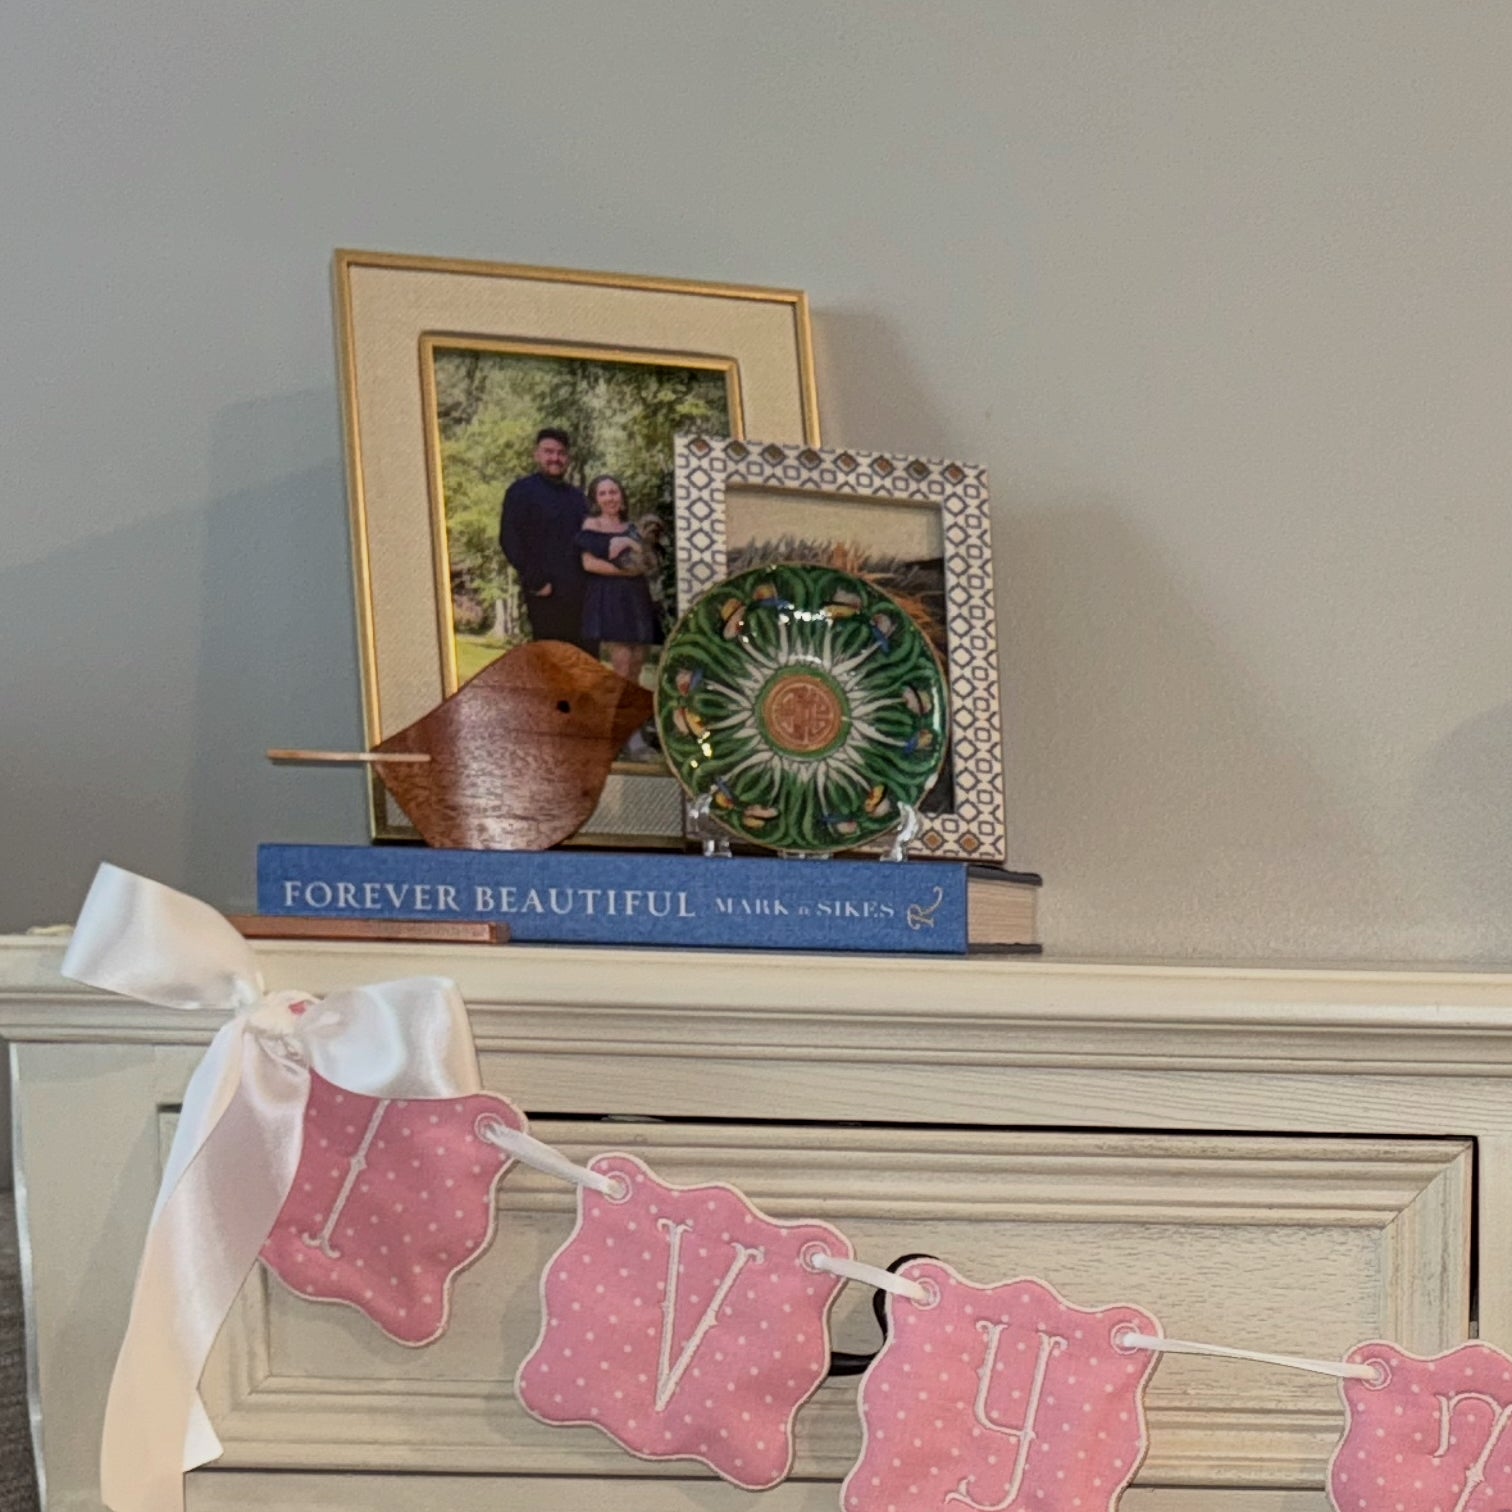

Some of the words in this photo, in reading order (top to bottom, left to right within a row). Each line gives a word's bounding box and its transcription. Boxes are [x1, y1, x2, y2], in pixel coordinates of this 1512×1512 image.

[284, 881, 460, 912] FOREVER
[475, 886, 696, 918] BEAUTIFUL
[715, 897, 789, 916] MARK
[816, 901, 895, 918] SIKES
